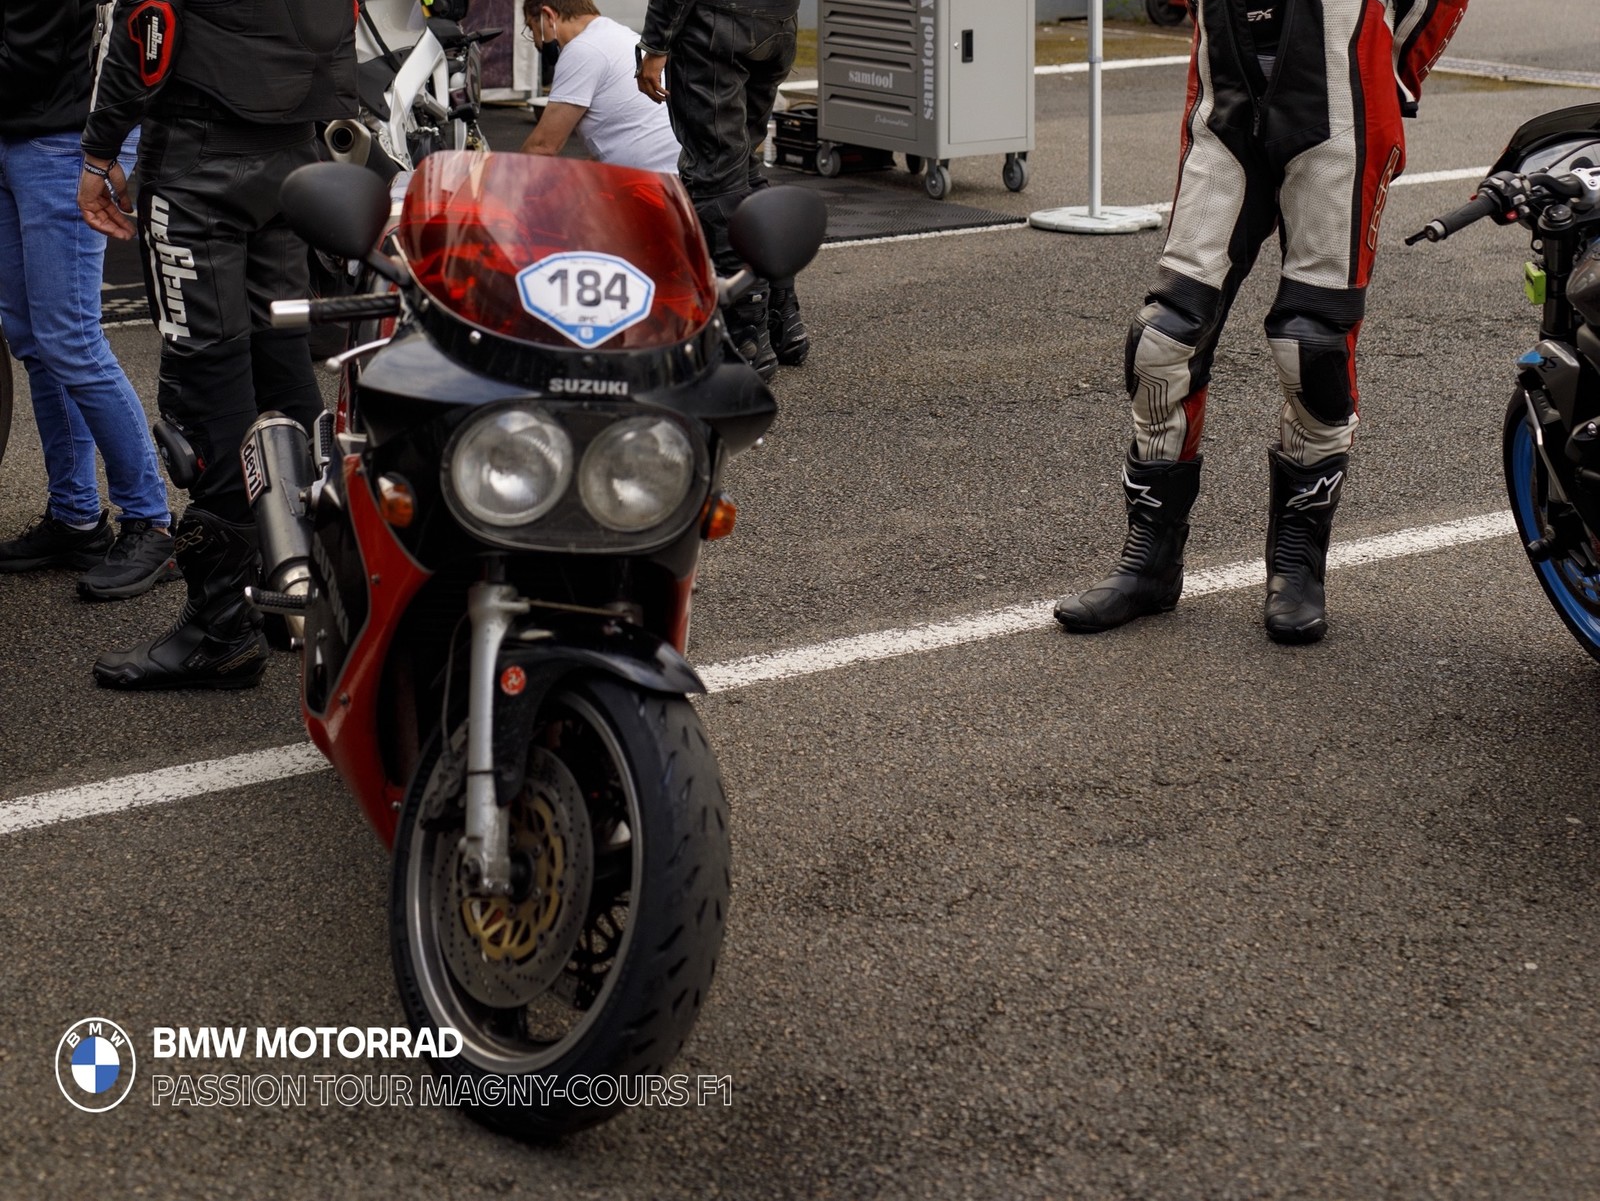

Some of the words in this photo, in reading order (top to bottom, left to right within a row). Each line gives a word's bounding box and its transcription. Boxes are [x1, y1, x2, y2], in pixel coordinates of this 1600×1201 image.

[848, 70, 893, 89] samtool
[919, 16, 935, 121] samtool
[547, 268, 630, 311] 184
[548, 377, 629, 396] SUZUKI
[243, 443, 262, 498] devil
